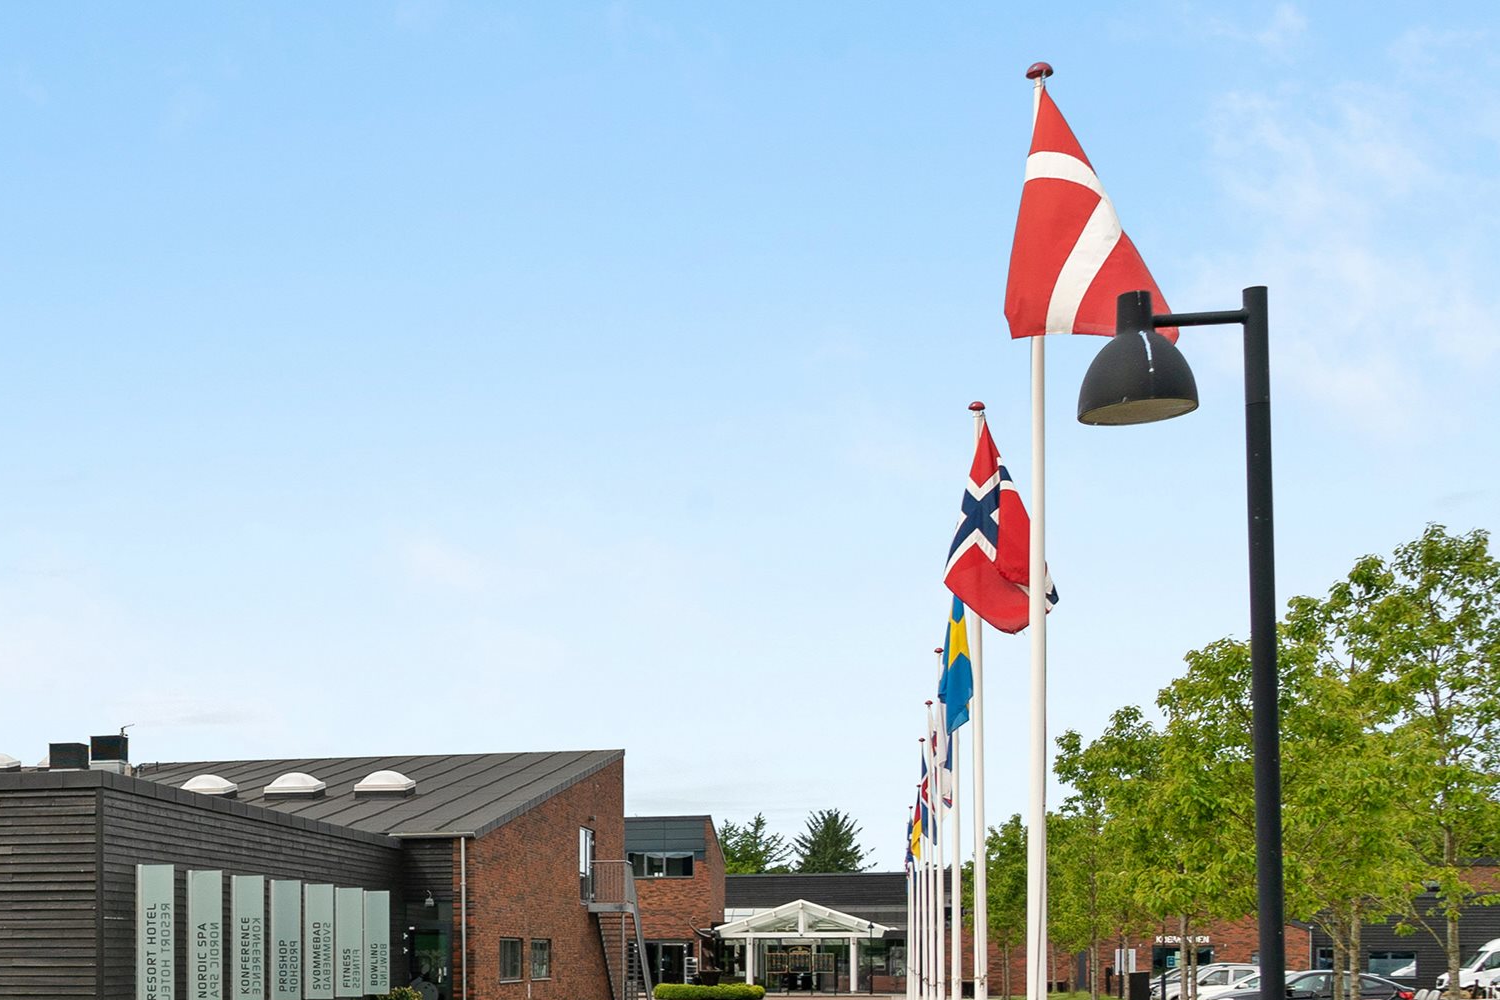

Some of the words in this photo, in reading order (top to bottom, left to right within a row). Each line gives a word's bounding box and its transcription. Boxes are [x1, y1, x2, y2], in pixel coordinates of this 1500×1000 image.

[146, 903, 157, 945] HOTEL
[197, 922, 207, 947] SPA
[197, 952, 207, 999] NORDIC
[240, 917, 250, 995] KONFERENCE
[278, 939, 288, 992] PROSHOP
[342, 948, 351, 988] FITNESS
[370, 943, 379, 986] BOWLING
